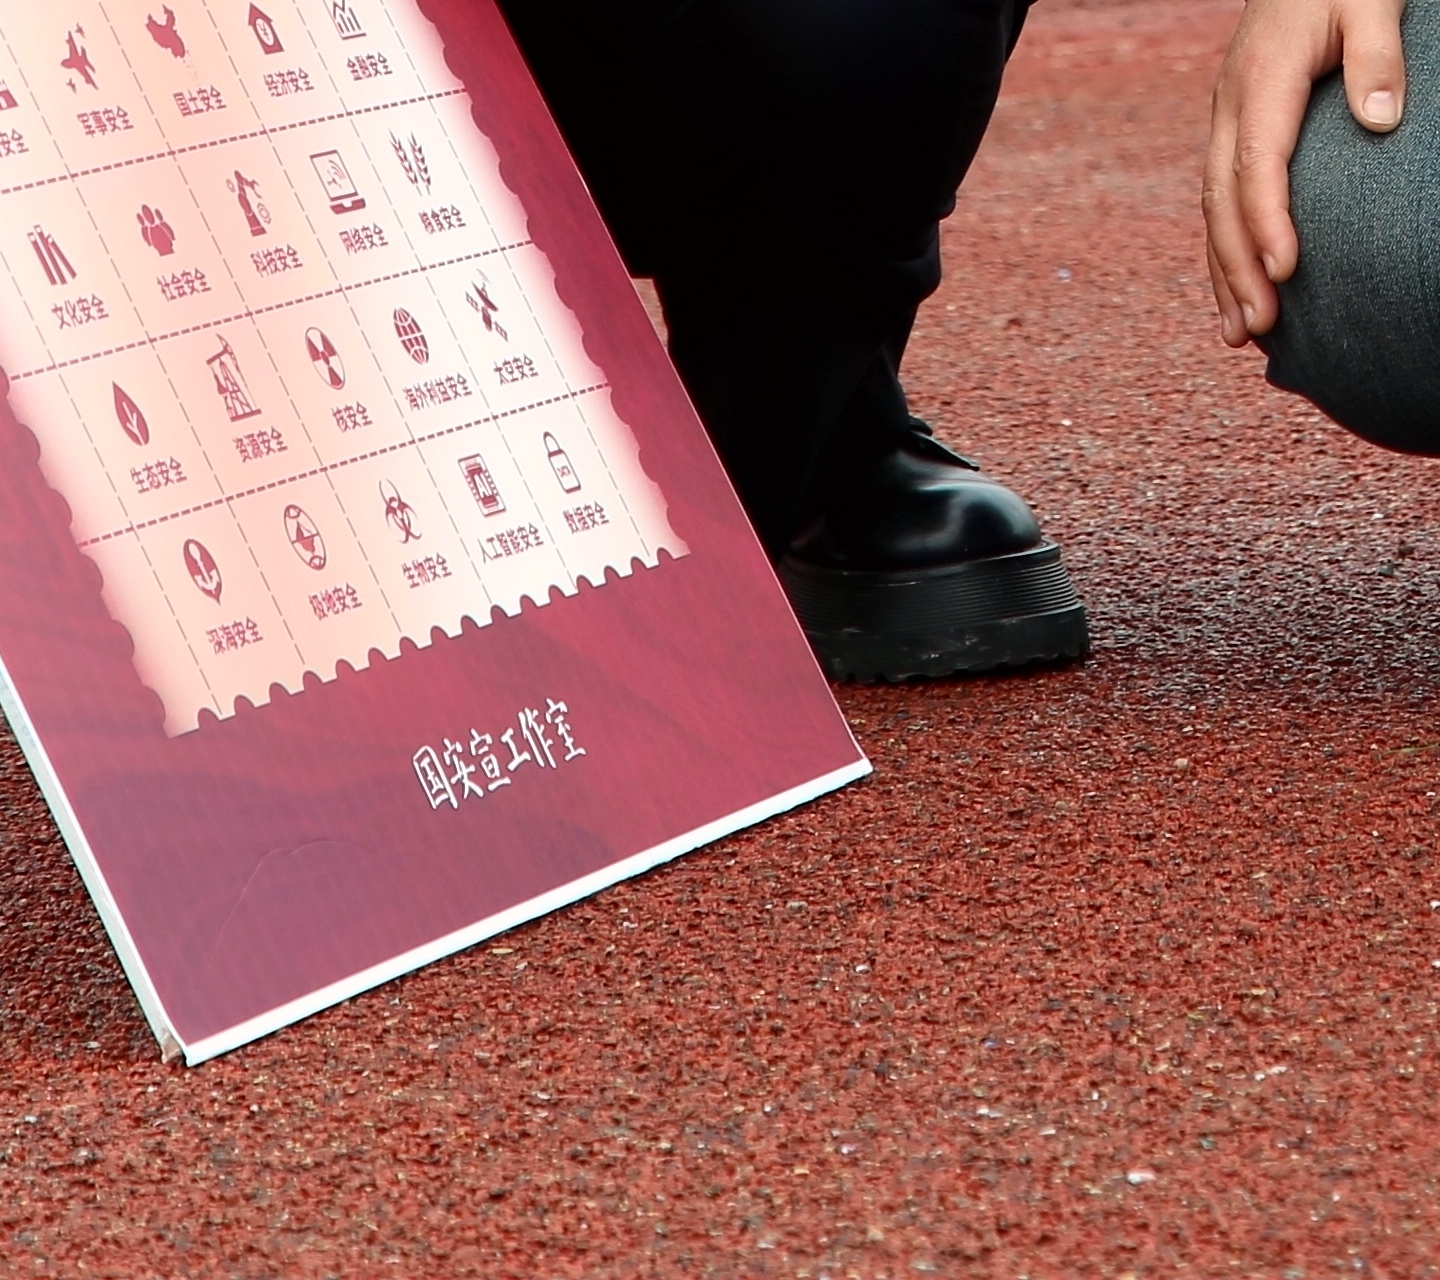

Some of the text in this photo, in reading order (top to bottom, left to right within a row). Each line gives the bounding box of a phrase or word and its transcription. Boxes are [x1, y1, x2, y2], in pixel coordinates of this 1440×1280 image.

[263, 67, 315, 97] 经济安全
[346, 52, 393, 81] 金融安全
[173, 85, 227, 117] 国土安全
[76, 105, 134, 137] 军事安全
[419, 205, 467, 234] 粮食安全
[339, 223, 389, 254] 网络安全
[250, 244, 303, 277] 科技安全
[157, 267, 212, 302] 社会安全
[51, 293, 109, 330] 文化安全
[493, 354, 539, 385] 太空安全
[403, 373, 472, 410] 海外利益安全
[331, 401, 373, 433] 核安全
[233, 426, 288, 463] 资源安全
[130, 456, 187, 494] 生态安全
[562, 501, 610, 534] 数据安全
[478, 523, 544, 563] 人工智能安全
[401, 553, 452, 589] 生物安全
[308, 582, 363, 621] 极地安全
[206, 616, 264, 655] 深海安全
